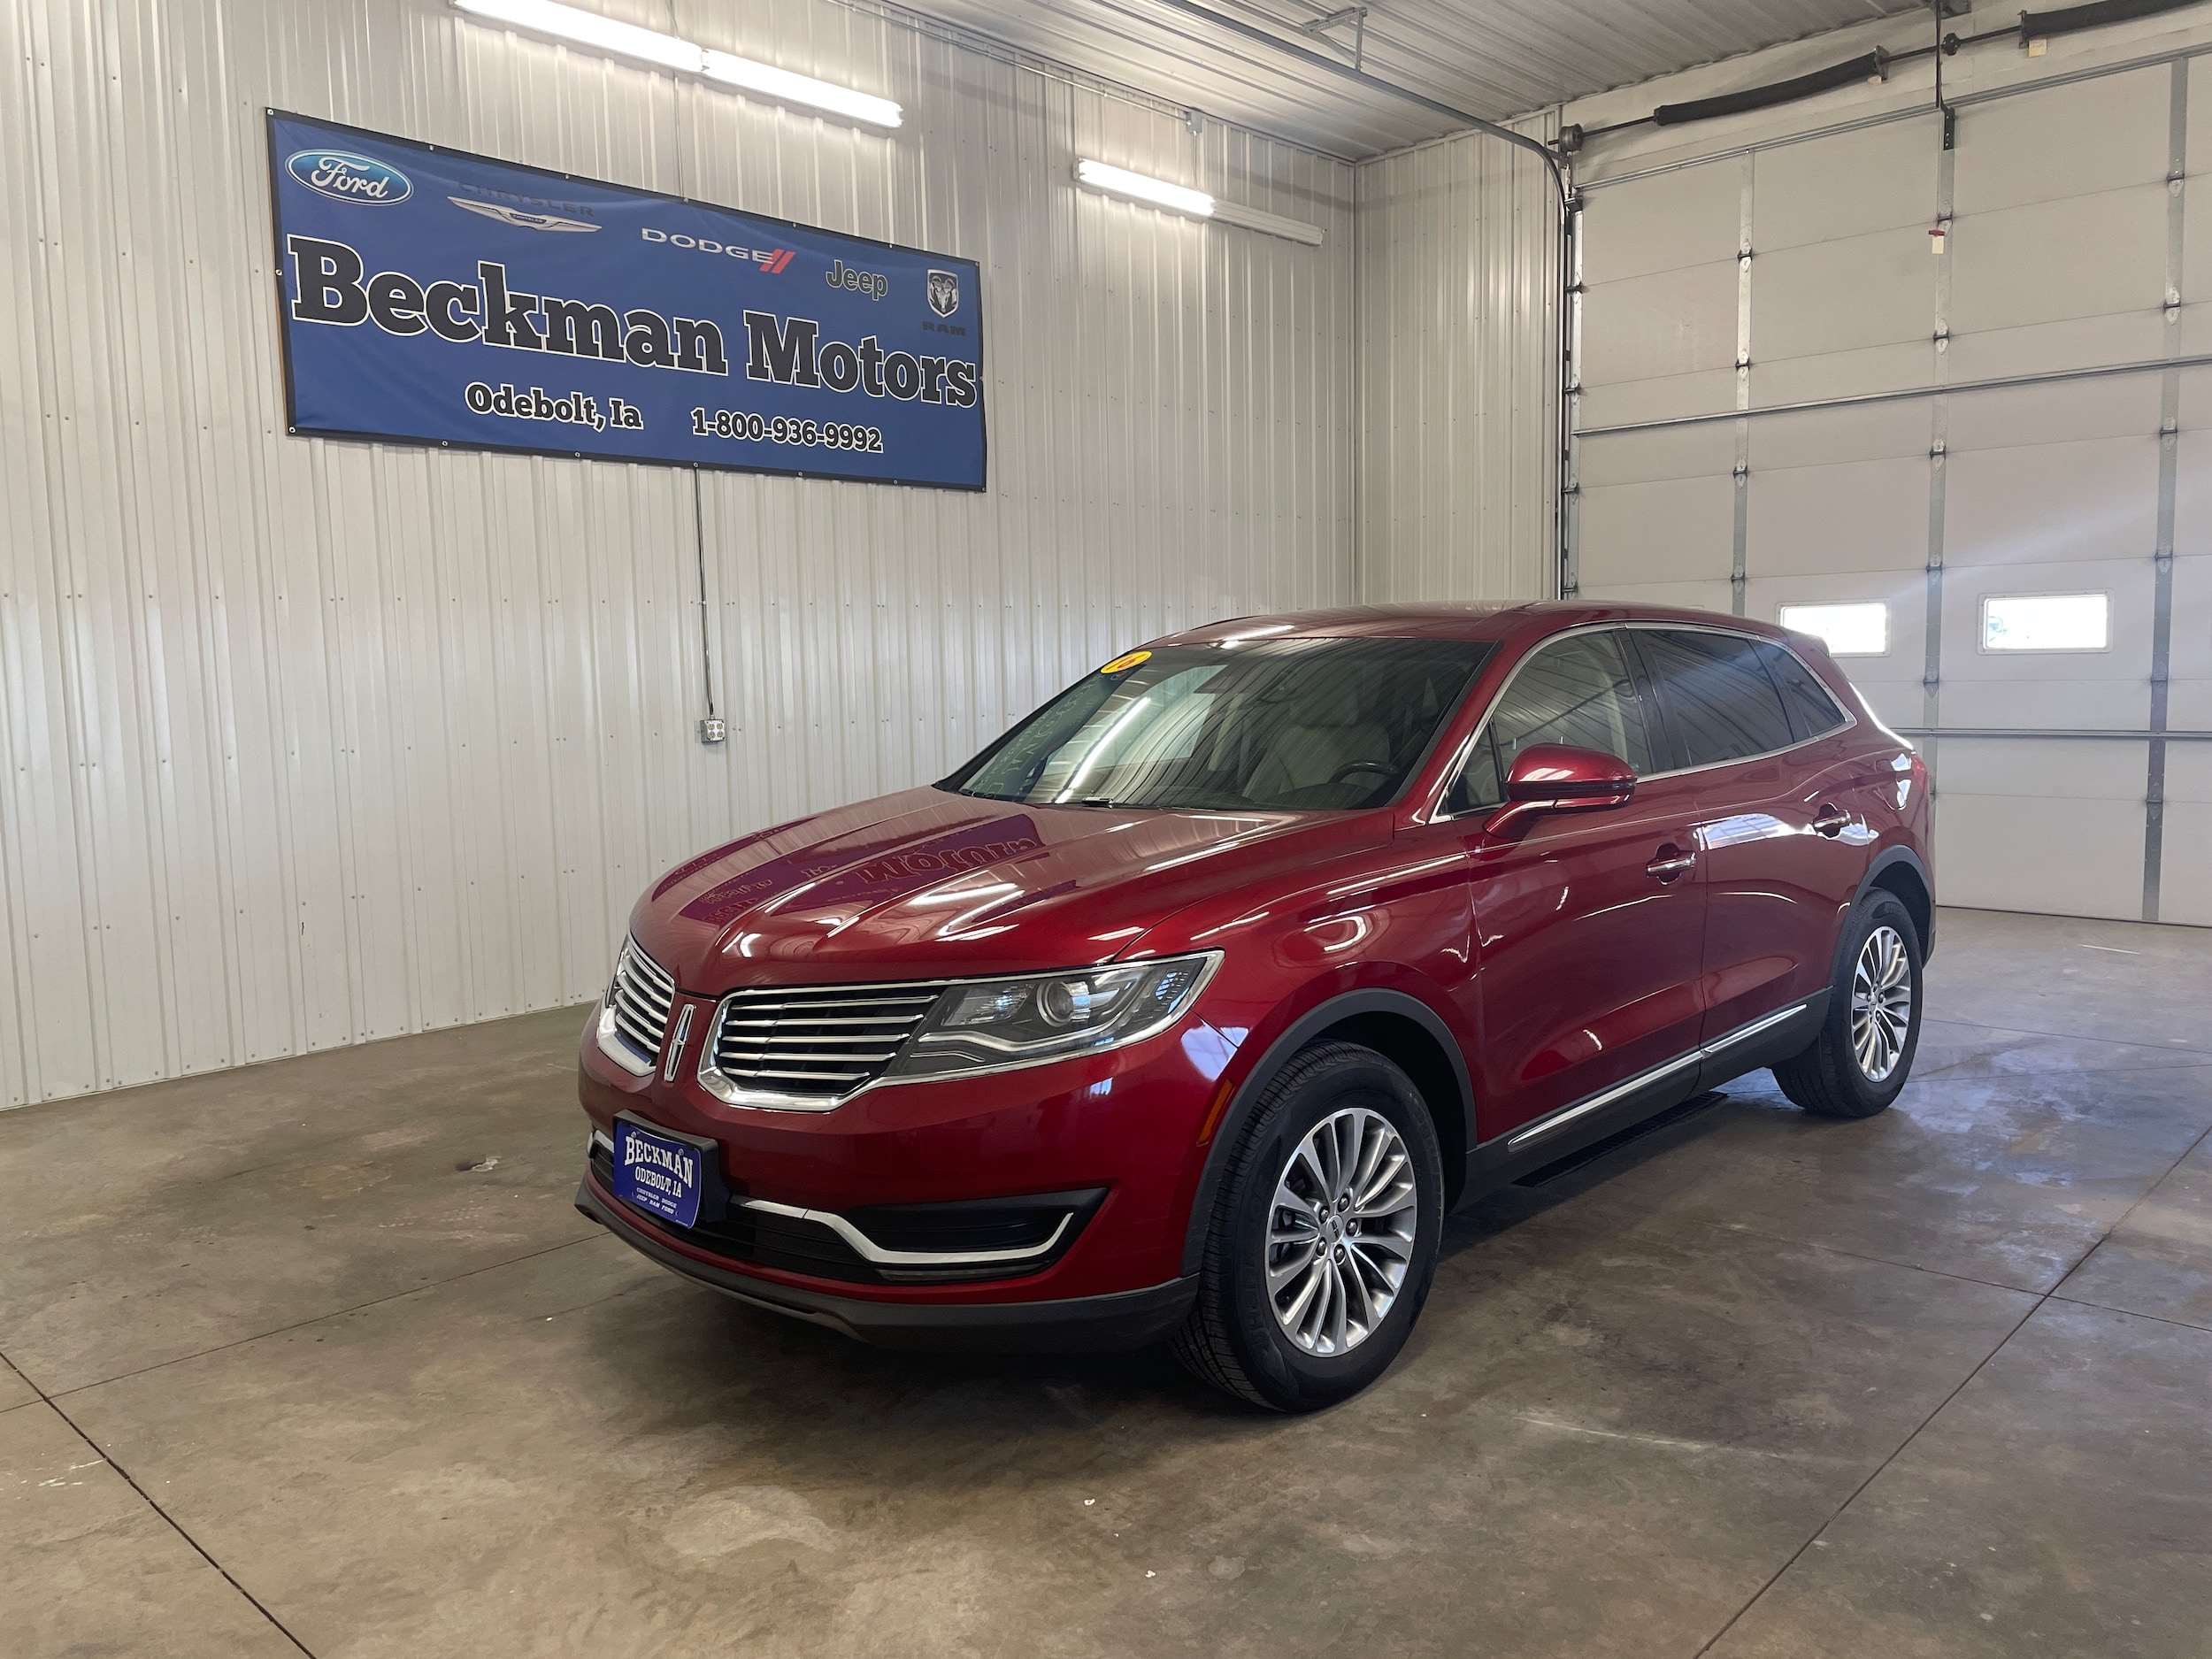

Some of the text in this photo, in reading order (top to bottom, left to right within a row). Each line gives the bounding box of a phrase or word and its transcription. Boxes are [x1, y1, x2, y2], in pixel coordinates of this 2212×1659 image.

[311, 157, 389, 198] Ford
[641, 227, 773, 264] DODGE
[826, 259, 887, 301] Jeep
[287, 234, 977, 409] Beckman Motors
[922, 320, 966, 336] RAM
[465, 381, 643, 433] Odebolt, Ia
[690, 407, 884, 453] 1-800-936-9992
[625, 1136, 694, 1188] BECKMAN
[634, 1166, 682, 1198] ODEBOLT, IA
